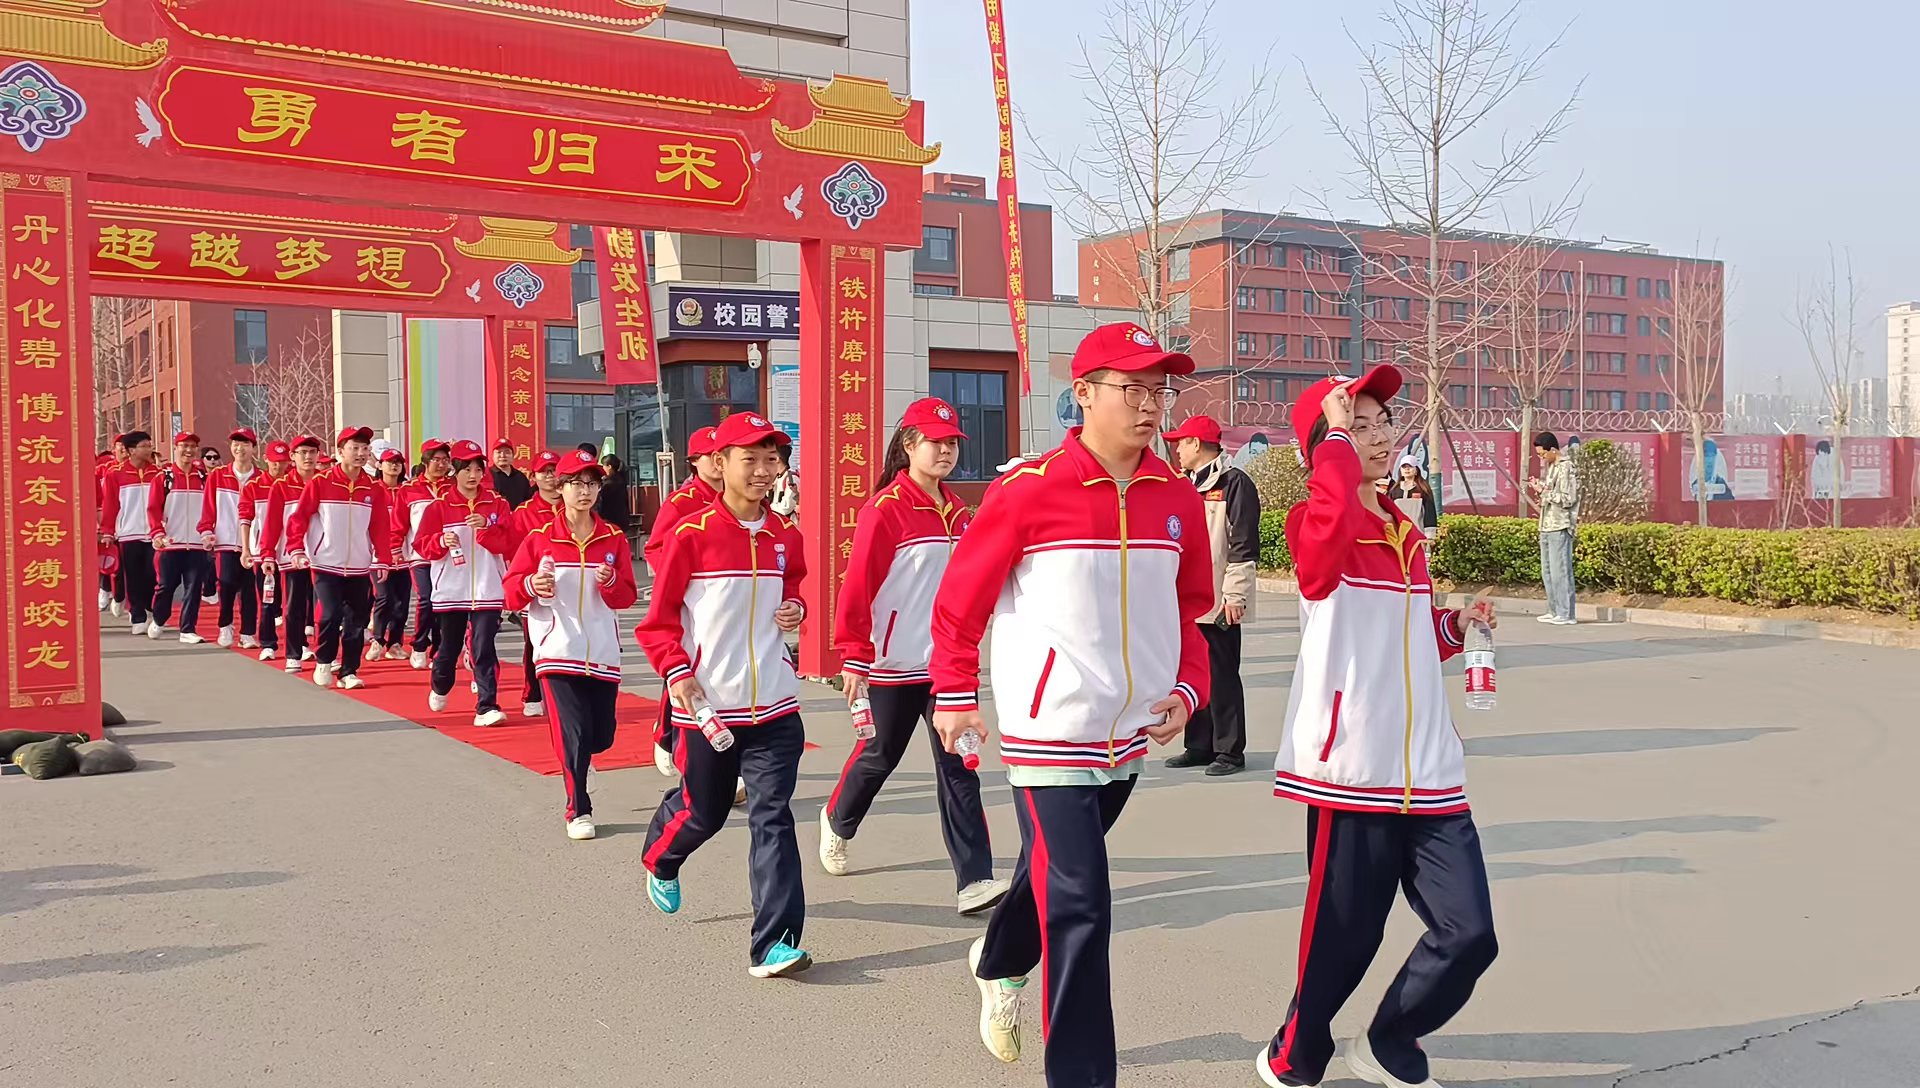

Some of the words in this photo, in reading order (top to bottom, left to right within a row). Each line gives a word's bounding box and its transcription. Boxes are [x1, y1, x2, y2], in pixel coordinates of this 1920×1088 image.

[237, 86, 722, 192] 勇者归来
[12, 213, 61, 369] 丹心化碧
[97, 223, 412, 289] 超越梦想
[509, 343, 532, 428] 感念亲恩
[838, 275, 868, 394] 铁杵磨针
[16, 391, 70, 671] 博流东海缚蛟龙
